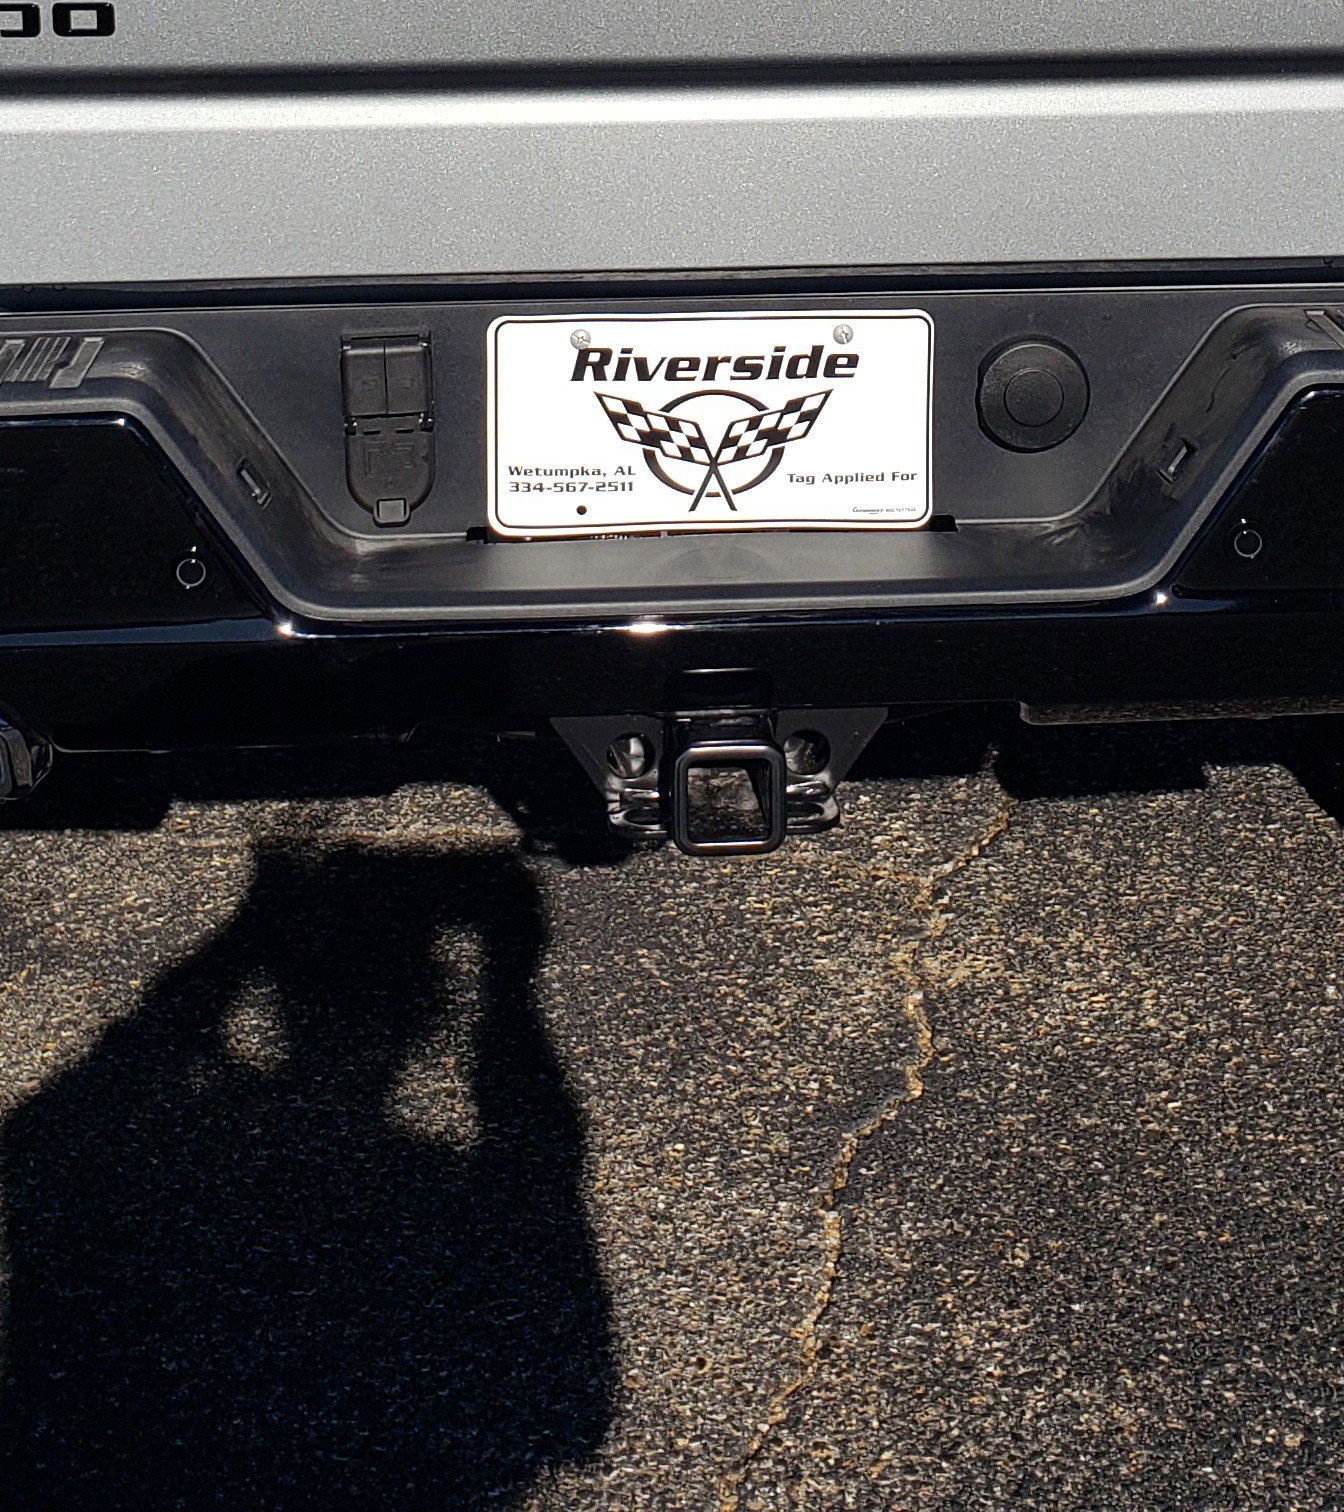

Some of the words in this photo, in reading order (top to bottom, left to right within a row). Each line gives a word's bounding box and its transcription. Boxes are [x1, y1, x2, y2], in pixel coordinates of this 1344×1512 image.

[569, 344, 861, 383] Riverside
[507, 465, 607, 479] Wetumpka,
[613, 464, 637, 477] AL
[787, 473, 816, 486] Tag
[821, 471, 886, 485] Applied
[890, 471, 918, 483] For
[508, 480, 635, 494] 334-567-2511
